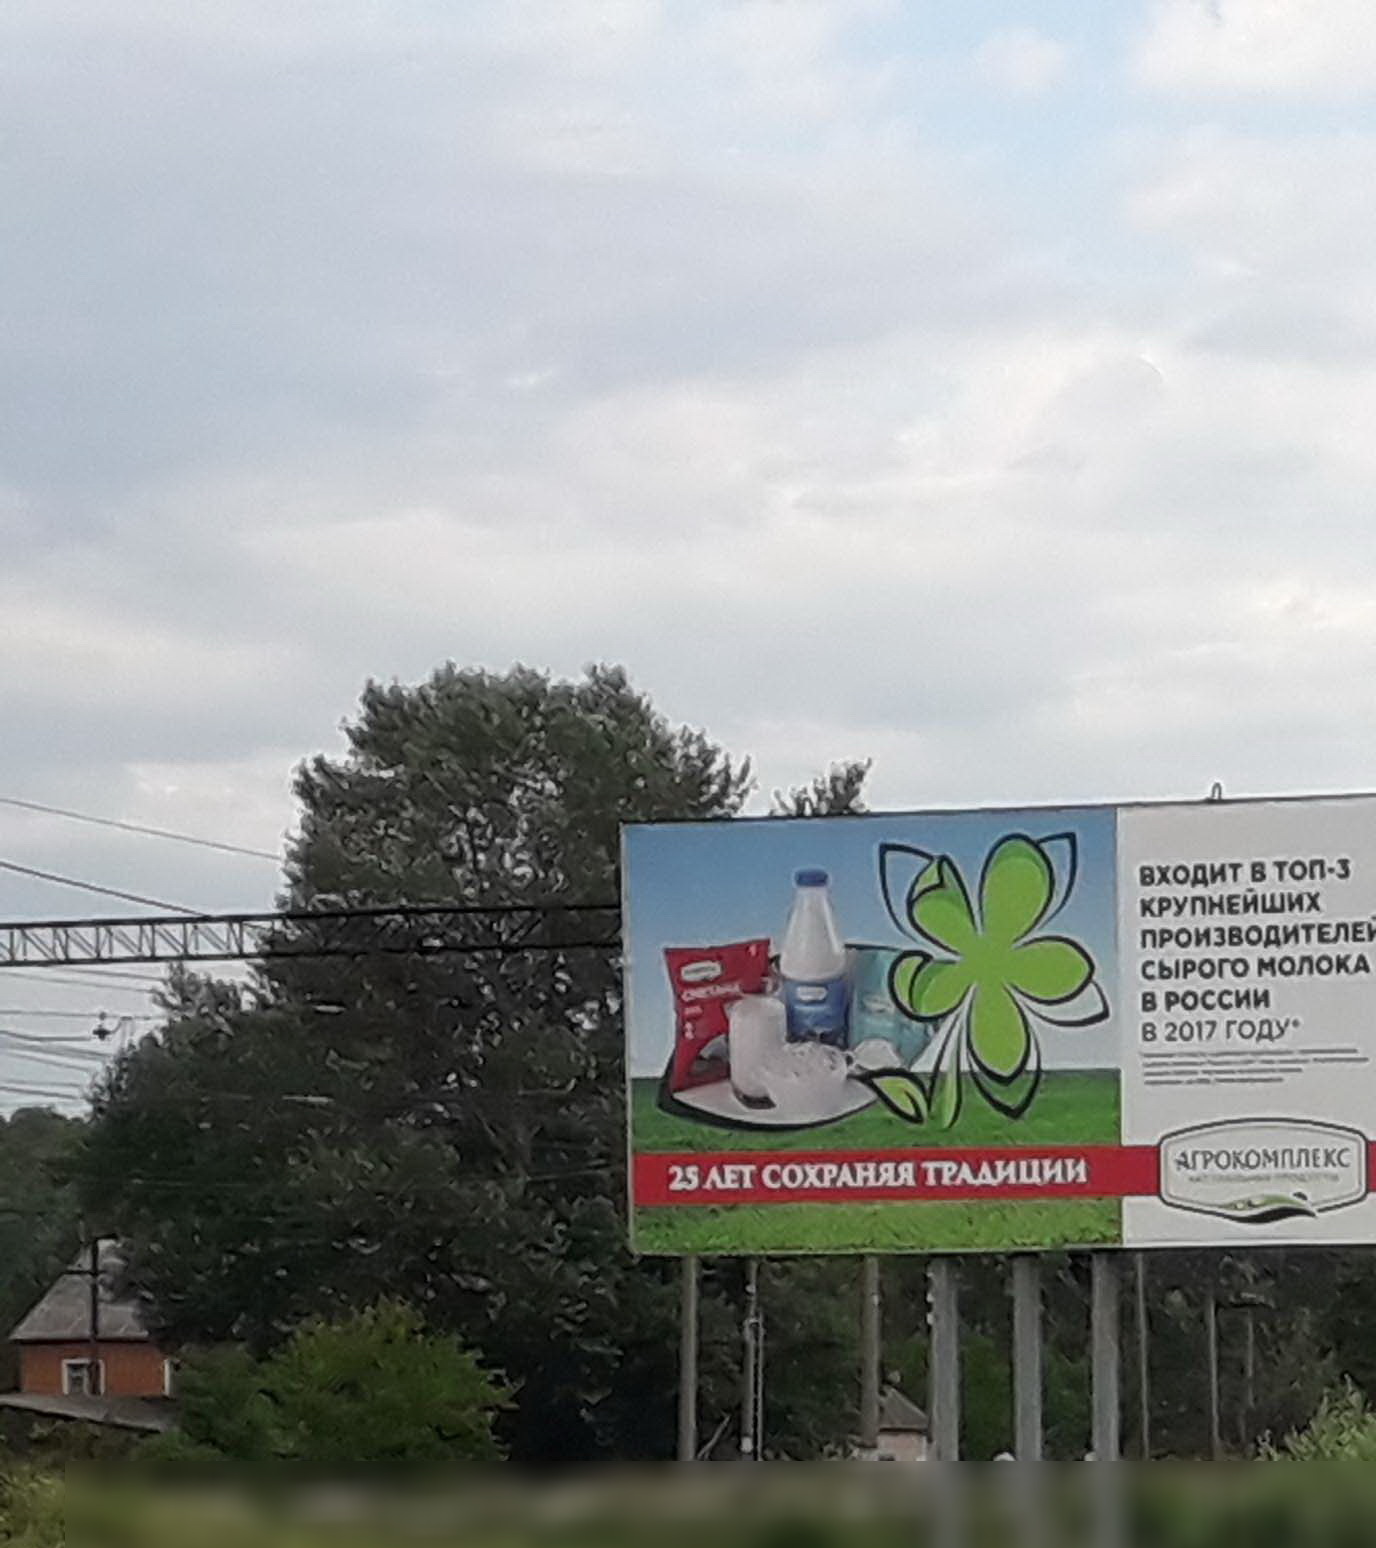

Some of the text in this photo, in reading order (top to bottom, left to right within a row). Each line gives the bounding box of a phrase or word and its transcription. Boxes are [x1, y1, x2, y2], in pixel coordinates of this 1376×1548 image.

[1139, 858, 1351, 887] ВХОДИТ В ТОП-3
[1140, 888, 1322, 918] КРУПНЕЙШИХ
[1141, 953, 1371, 981] СЫРОГО МОЛОКА
[1141, 988, 1270, 1012] В РОССИИ
[1141, 1022, 1157, 1042] В
[1164, 1020, 1217, 1042] 2017
[1175, 1147, 1351, 1171] АГРОКОМПЛЕКС
[668, 1158, 1088, 1191] 25 ЛЕТ СОХРАНЯЯ ТРАДИЦИИ
